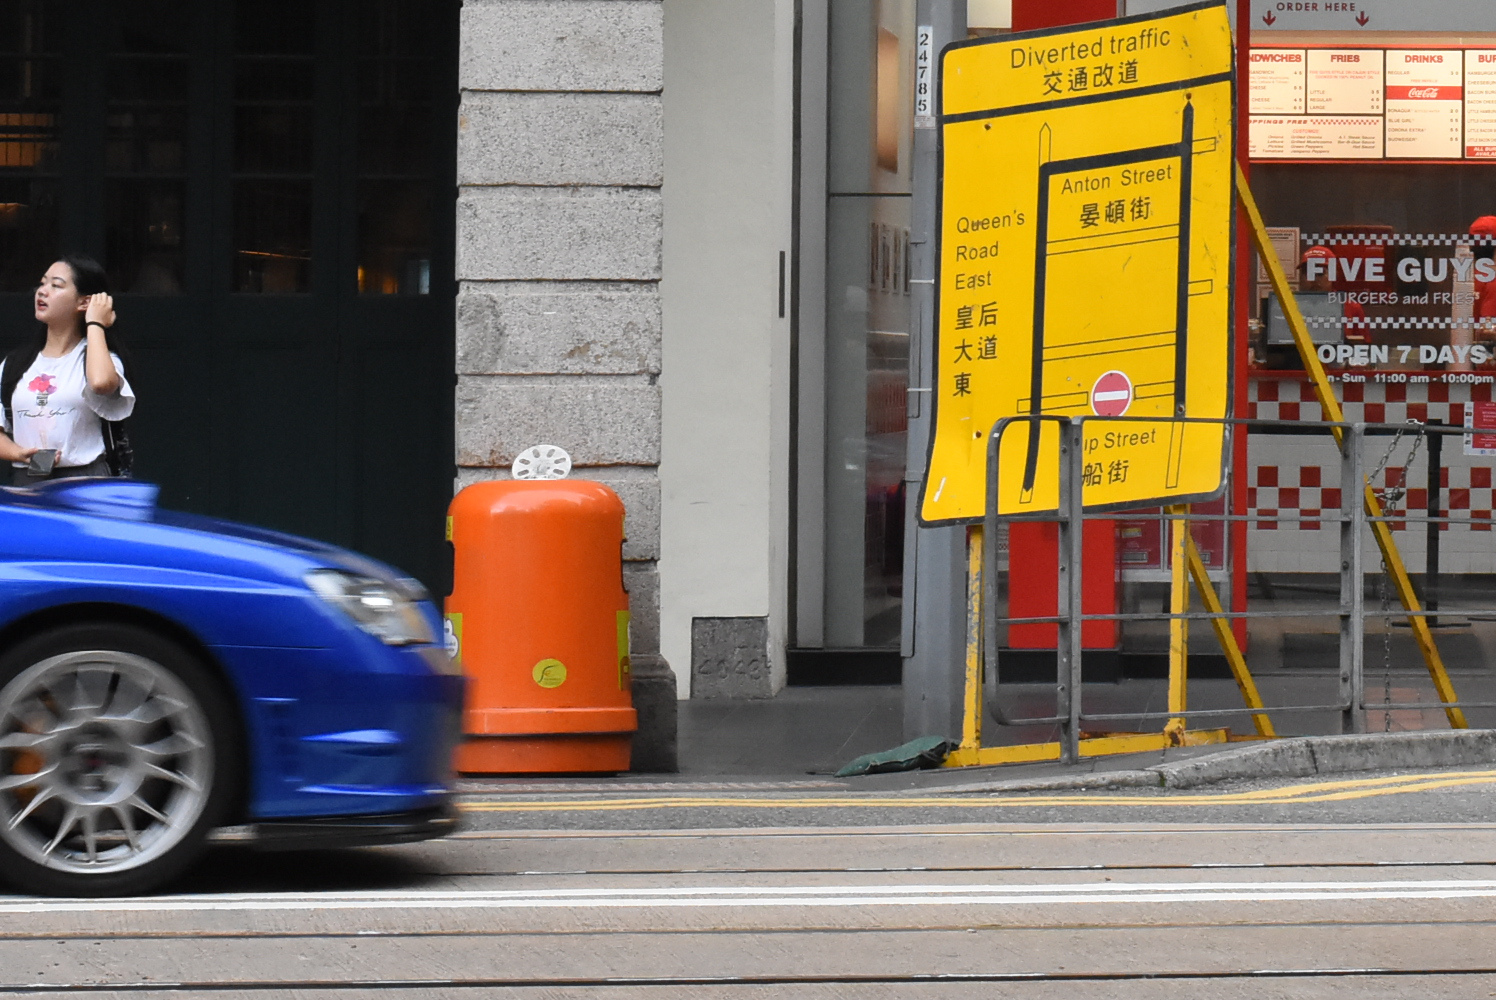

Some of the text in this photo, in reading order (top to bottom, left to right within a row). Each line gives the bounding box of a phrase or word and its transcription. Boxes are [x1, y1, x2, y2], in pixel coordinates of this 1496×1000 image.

[1276, 2, 1356, 12] ORDER HERE
[1010, 27, 1171, 70] Diverted traffic
[1249, 54, 1302, 63] NDWICHES
[1330, 54, 1360, 63] FRIES
[1405, 55, 1443, 63] DRINKS
[918, 32, 929, 112] 24785
[1043, 60, 1139, 96] 交通改道
[1061, 164, 1173, 195] Anton Street
[956, 210, 1026, 235] Queen's
[1079, 196, 1151, 229] 晏頓街
[956, 241, 999, 263] Road
[955, 270, 992, 291] East
[1306, 257, 1496, 283] FIVE GUYS
[1327, 291, 1399, 305] BURGERS
[1402, 293, 1428, 305] and
[955, 301, 999, 331] 皇后
[954, 334, 999, 364] 大道
[1317, 345, 1487, 364] OPEN 7 DAYS
[953, 371, 972, 397] 東
[1374, 374, 1407, 383] 11:00
[1410, 375, 1429, 383] am
[1441, 374, 1494, 385] 10:00pm
[1104, 427, 1157, 449] Street
[1082, 459, 1130, 488] 船街
